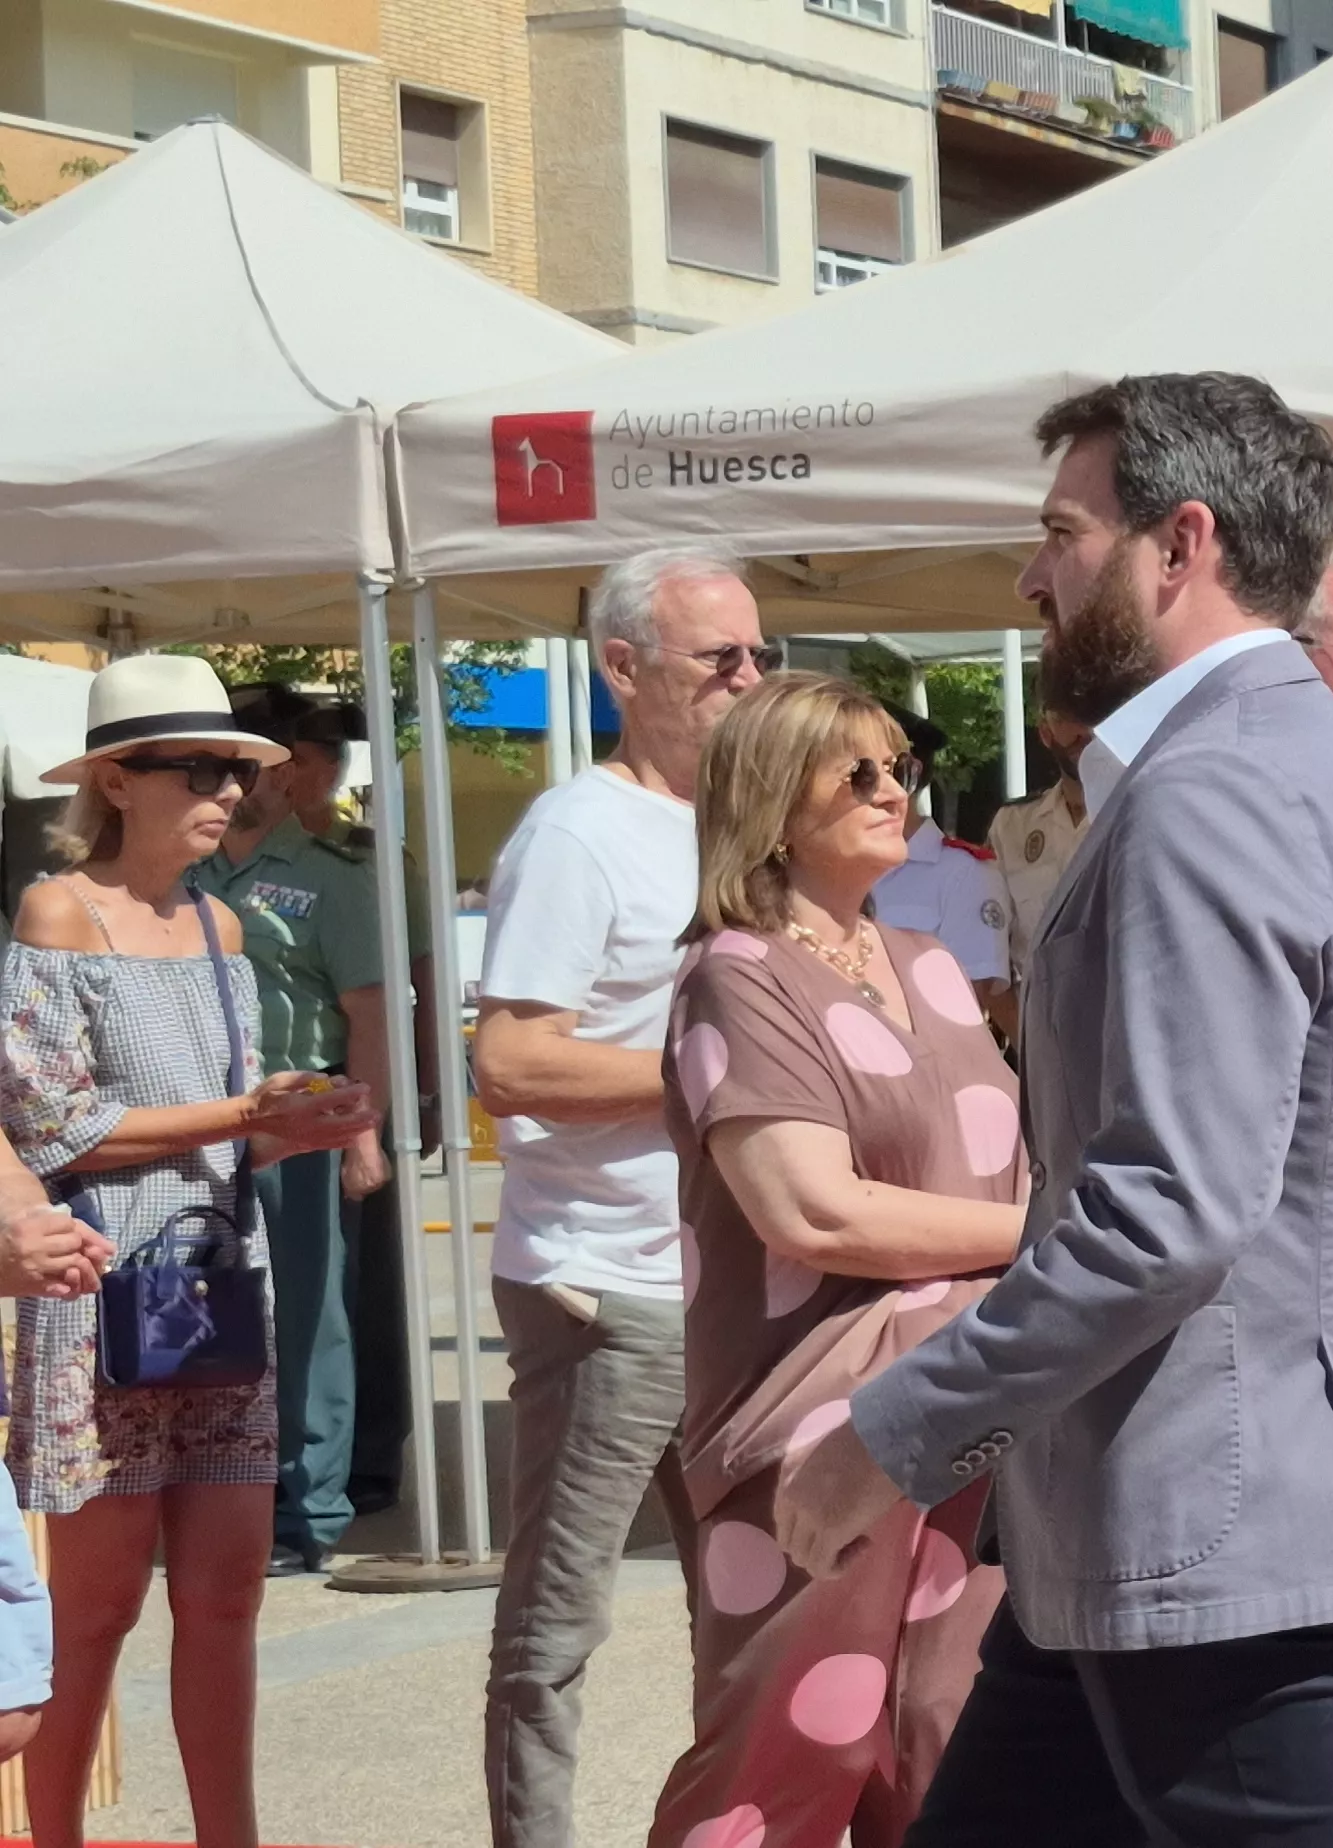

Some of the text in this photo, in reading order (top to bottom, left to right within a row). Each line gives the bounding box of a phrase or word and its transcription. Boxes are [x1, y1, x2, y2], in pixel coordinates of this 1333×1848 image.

[608, 397, 875, 449] Ayuntamiento
[611, 450, 811, 490] de Huesca
